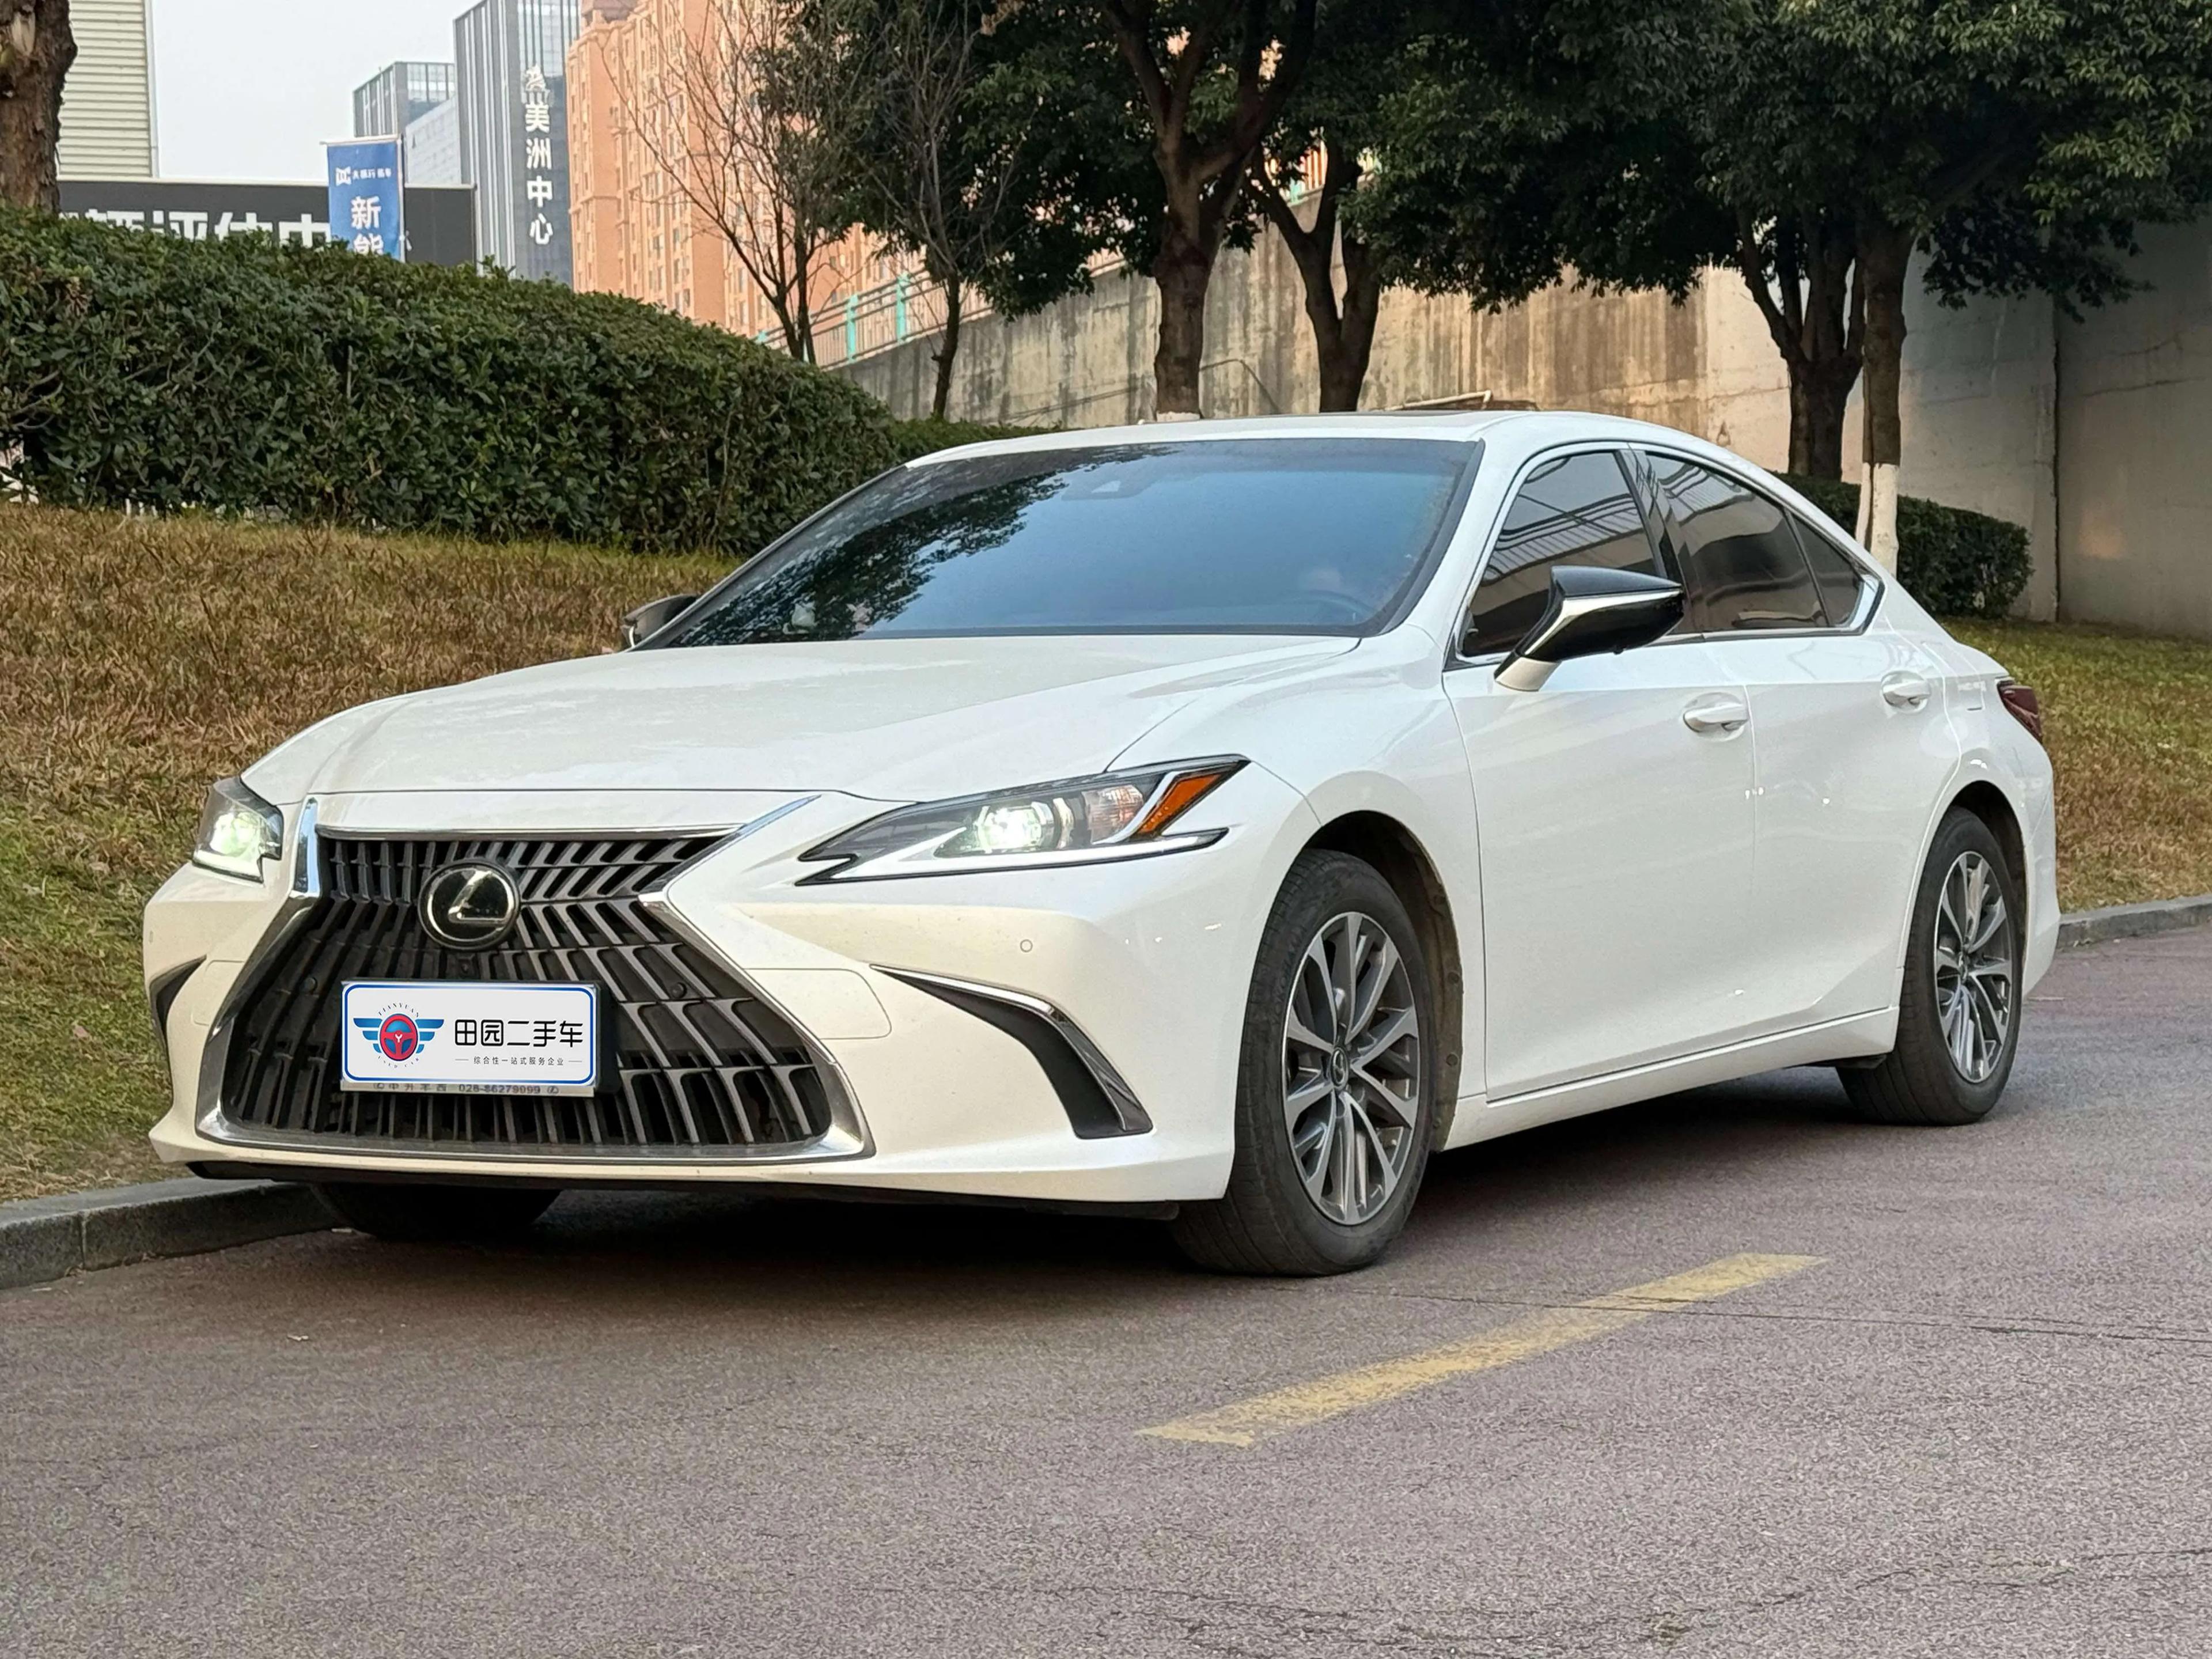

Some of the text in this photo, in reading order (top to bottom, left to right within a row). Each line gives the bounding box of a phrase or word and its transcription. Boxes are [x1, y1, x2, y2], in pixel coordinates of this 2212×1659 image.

[525, 101, 554, 245] 美洲中心
[454, 1019, 584, 1047] 田园二手车
[473, 1056, 565, 1066] 综合性一站式服务企业
